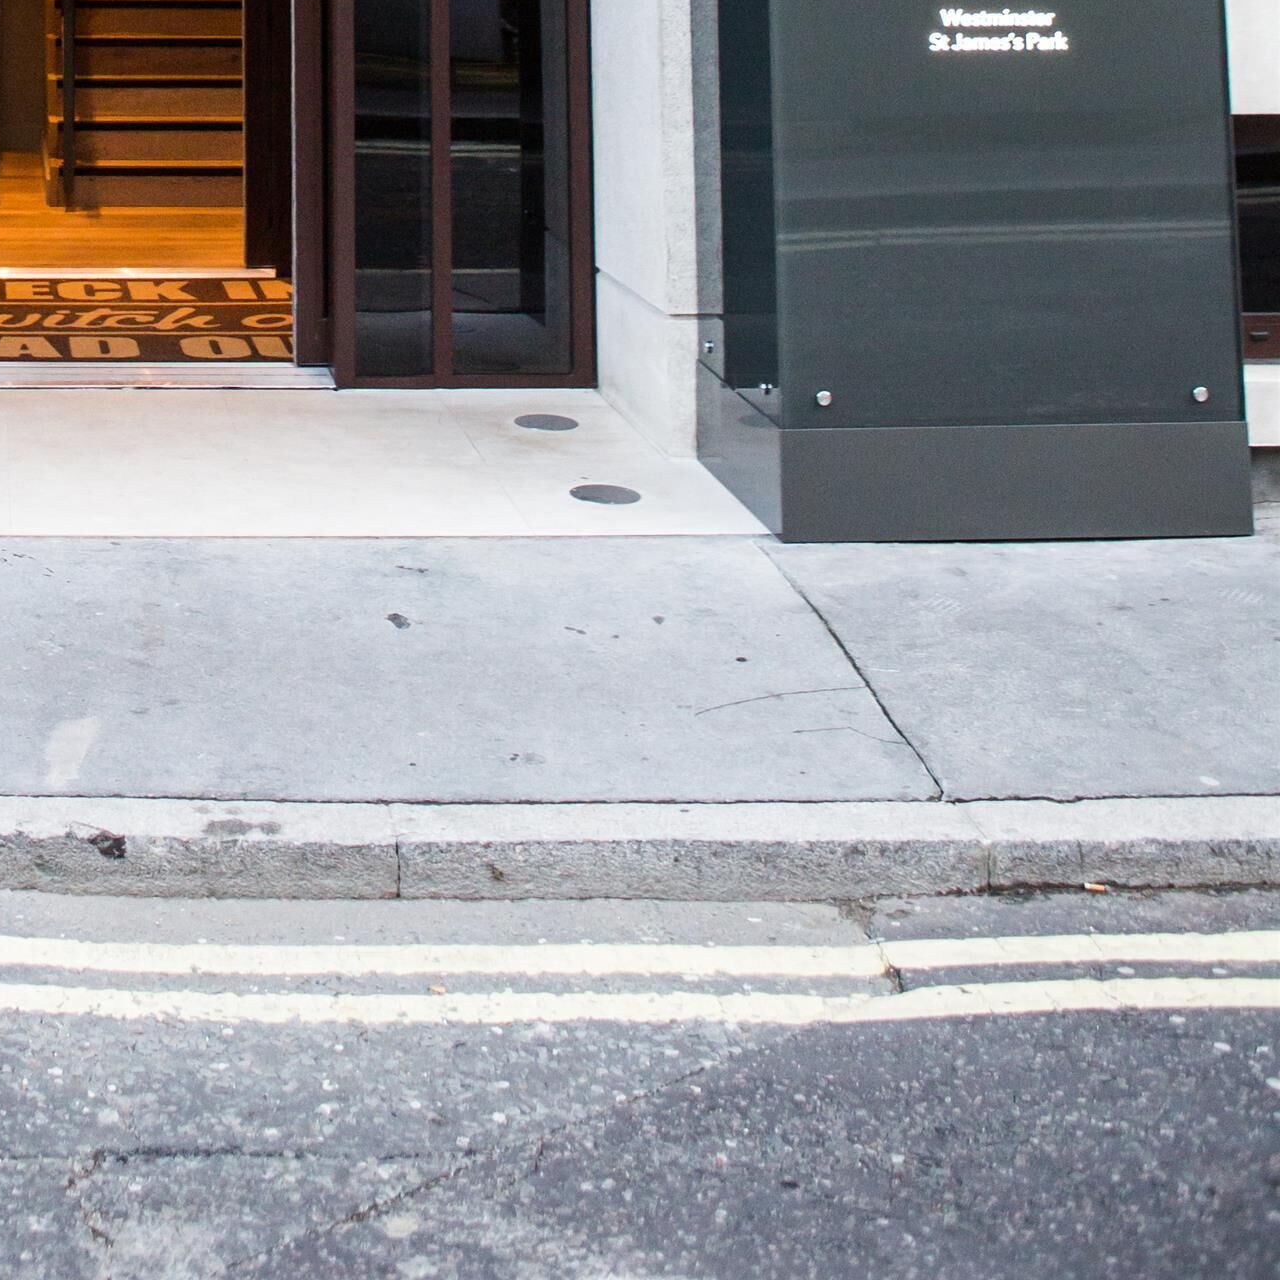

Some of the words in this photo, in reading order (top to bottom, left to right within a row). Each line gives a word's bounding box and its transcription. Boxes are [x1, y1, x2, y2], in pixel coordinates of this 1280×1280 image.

[939, 8, 1056, 27] Westminster
[928, 32, 950, 51] St
[951, 32, 1024, 51] James's
[1025, 31, 1069, 51] Park
